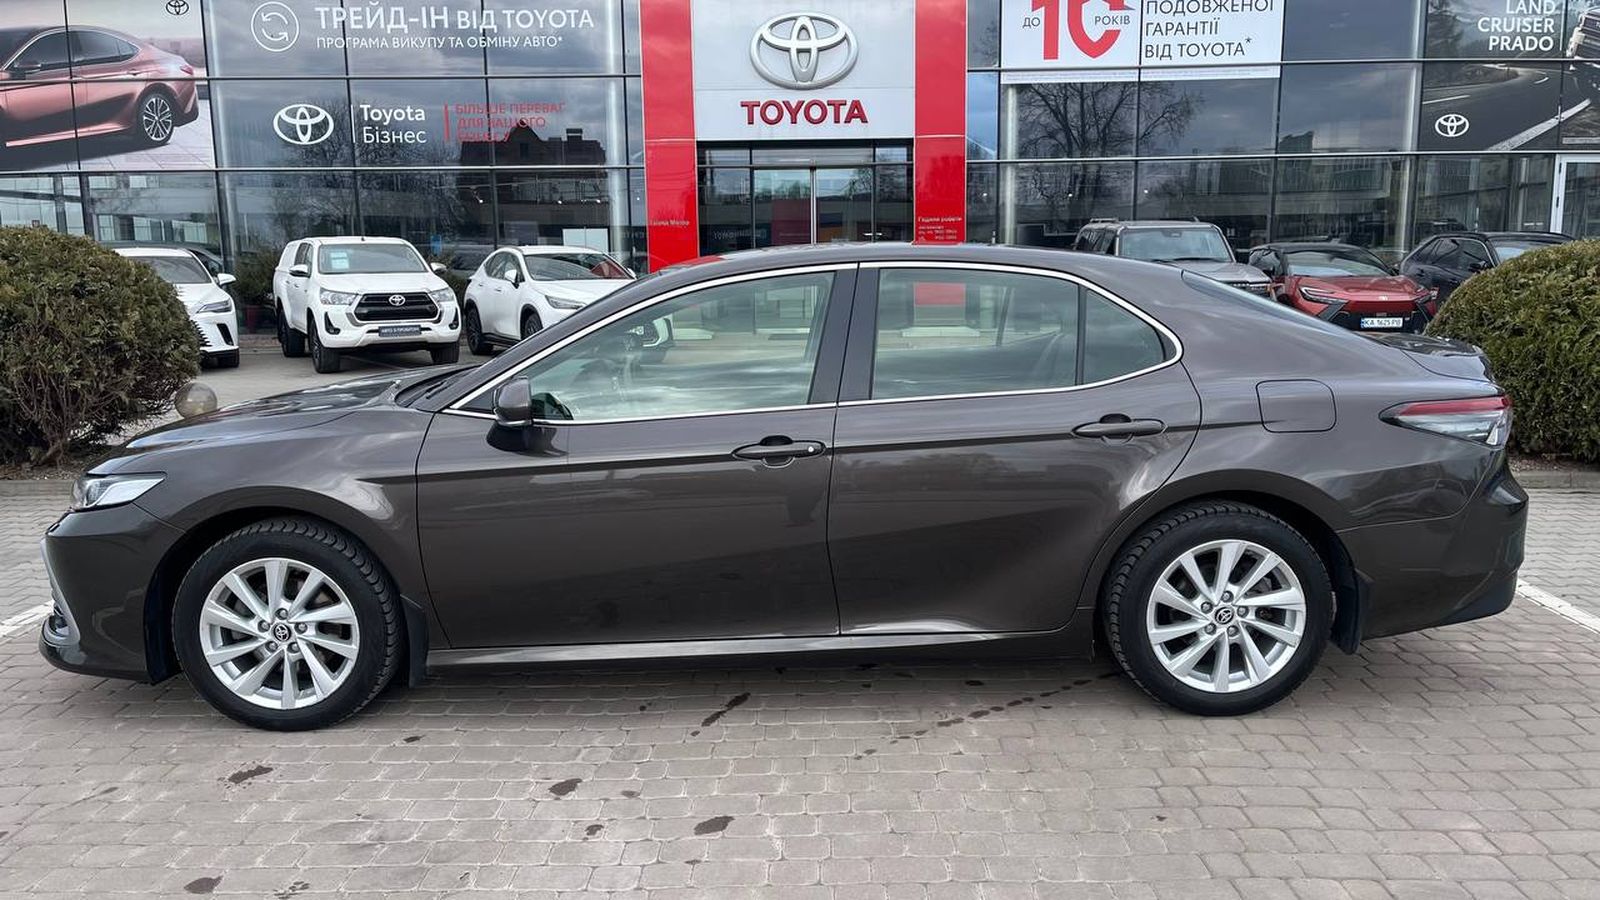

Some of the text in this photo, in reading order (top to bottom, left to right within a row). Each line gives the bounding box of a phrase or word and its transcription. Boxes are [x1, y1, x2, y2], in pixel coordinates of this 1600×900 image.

[1506, 0, 1556, 14] LAND
[316, 2, 594, 32] ТРЕЙД-ІН ВІД TOYOTA
[1022, 16, 1041, 28] ДО
[1094, 15, 1131, 26] РОКІВ
[1477, 17, 1555, 33] CRUISER
[1146, 17, 1219, 37] ГАРАНТІЇ
[316, 36, 389, 49] ПРОГРАМА
[393, 36, 444, 49] ВИКУПУ
[448, 36, 464, 48] ТА
[467, 36, 520, 49] ОБМІНУ
[1488, 35, 1554, 51] PRADO
[1145, 43, 1172, 60] ВІД
[359, 105, 426, 123] Toyota
[740, 99, 869, 125] TOYOTA
[363, 126, 427, 144] Бізнес
